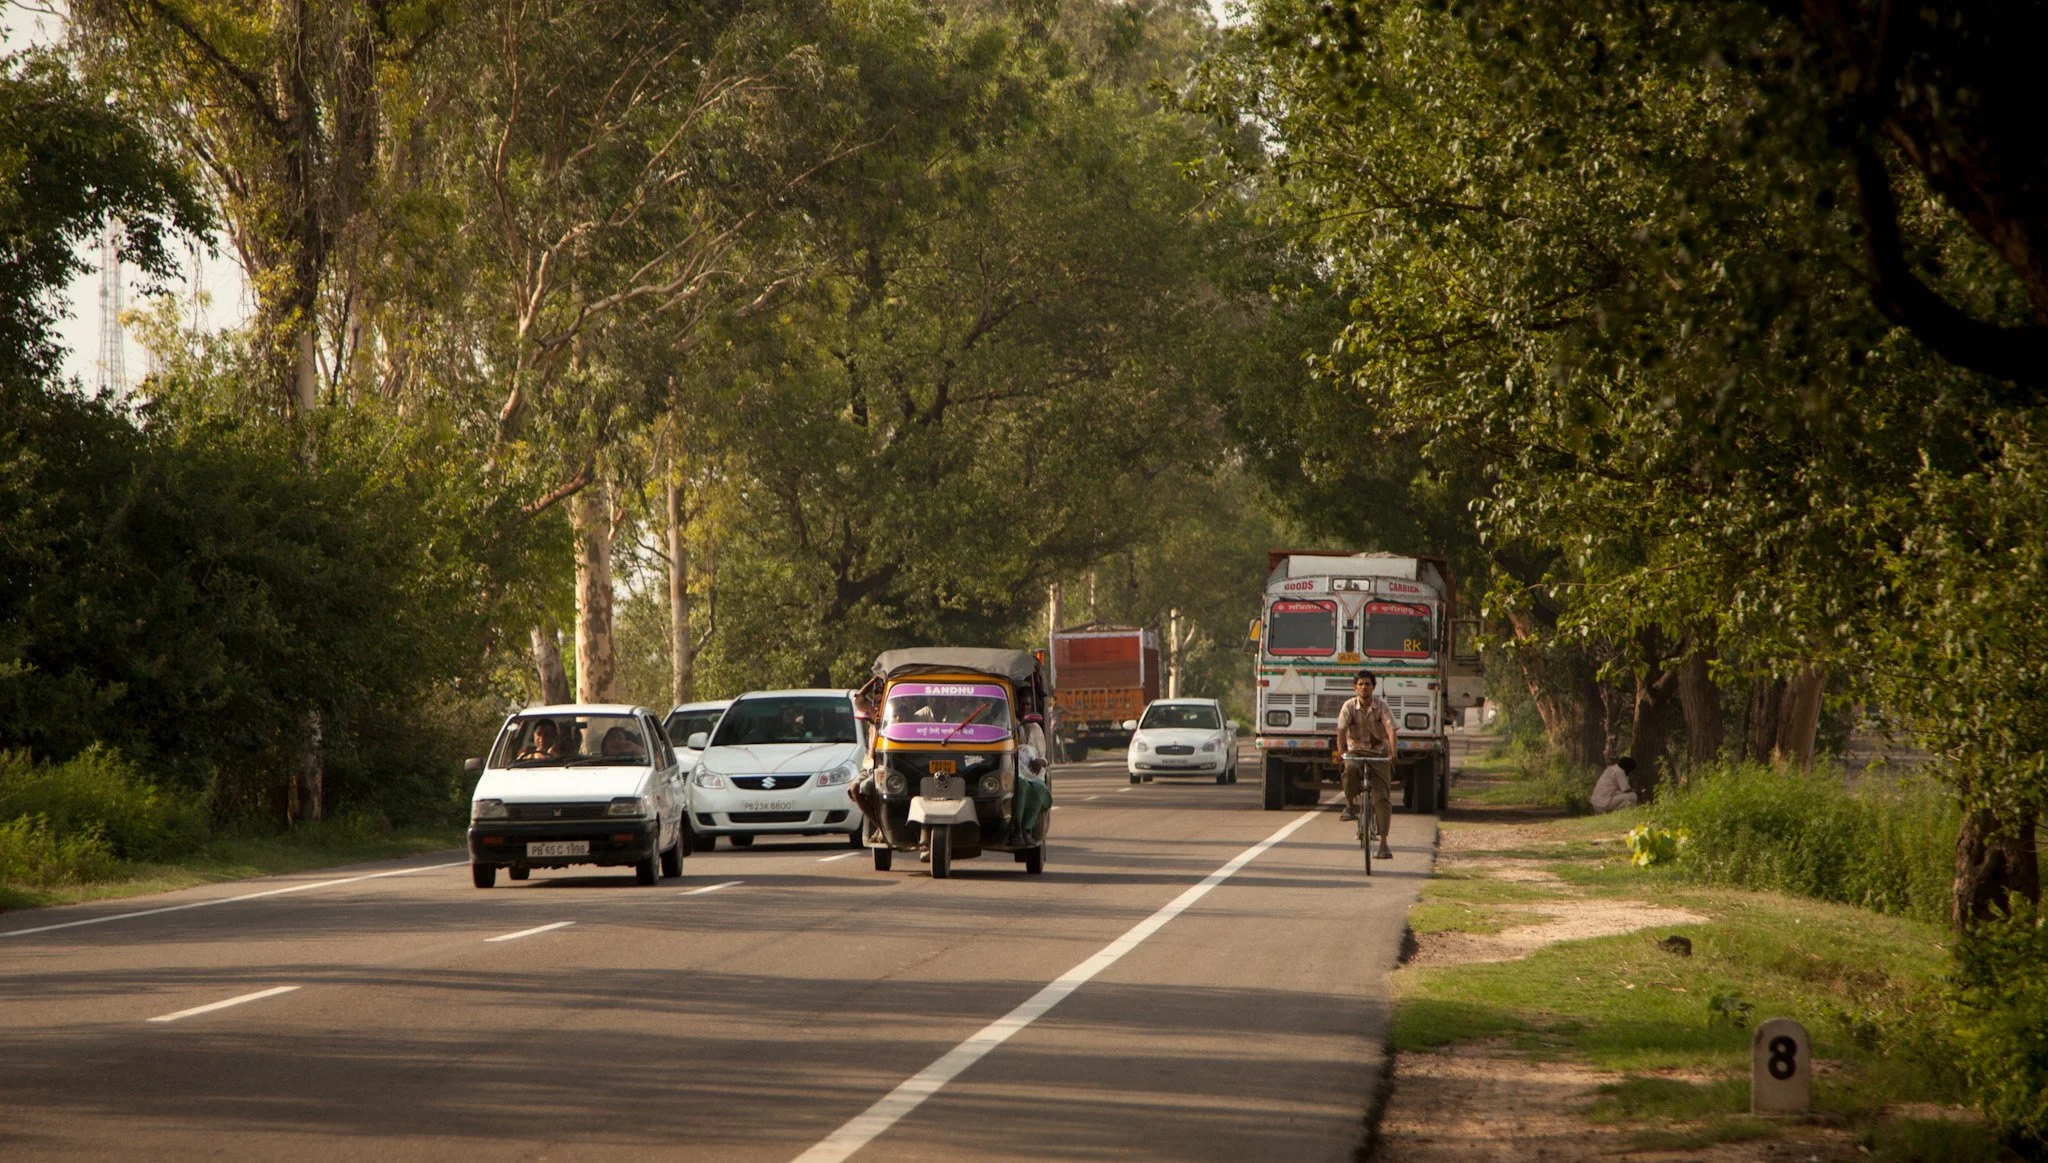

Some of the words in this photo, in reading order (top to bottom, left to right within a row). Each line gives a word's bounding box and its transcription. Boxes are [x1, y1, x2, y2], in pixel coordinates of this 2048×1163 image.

[1284, 580, 1314, 591] GOODS
[1403, 638, 1421, 652] RK
[924, 686, 975, 695] SANDHU
[531, 846, 543, 856] PB
[557, 845, 564, 855] C
[1767, 1035, 1797, 1081] 8
